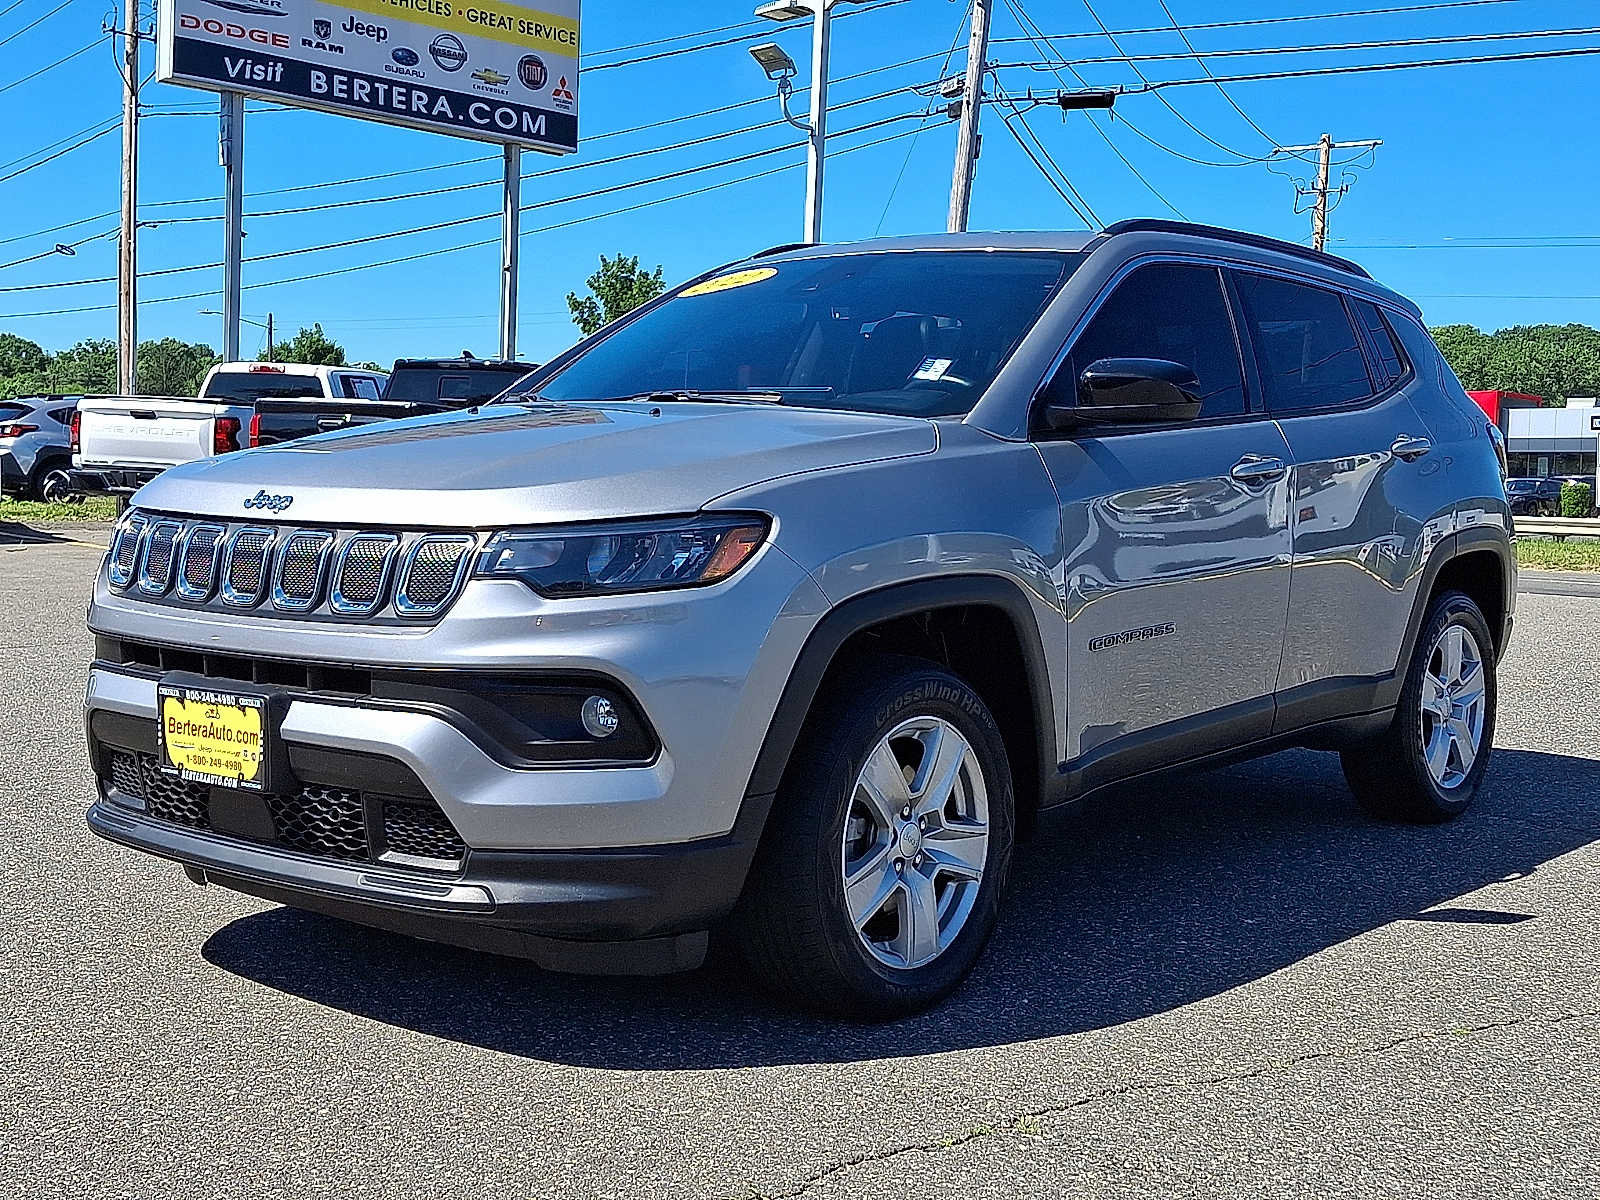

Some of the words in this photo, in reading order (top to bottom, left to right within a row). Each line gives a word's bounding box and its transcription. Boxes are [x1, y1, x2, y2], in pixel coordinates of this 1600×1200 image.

[180, 14, 290, 49] DODGE
[341, 16, 388, 43] Jeep
[466, 8, 514, 32] GREAT
[518, 19, 576, 46] SERVICE
[301, 38, 345, 55] RAM
[432, 46, 464, 59] NISSAN
[384, 64, 426, 79] SUBARU
[525, 64, 541, 81] FIAT
[223, 56, 284, 83] Visit
[310, 70, 546, 137] BERTERA.COM
[472, 83, 509, 96] CHEVROLET
[243, 489, 294, 515] Jeep
[1088, 621, 1177, 652] COMPASS
[185, 689, 236, 706] 800-249-4980
[168, 717, 259, 747] BerteraAuto.com
[186, 754, 243, 772] 1-800-249-4980
